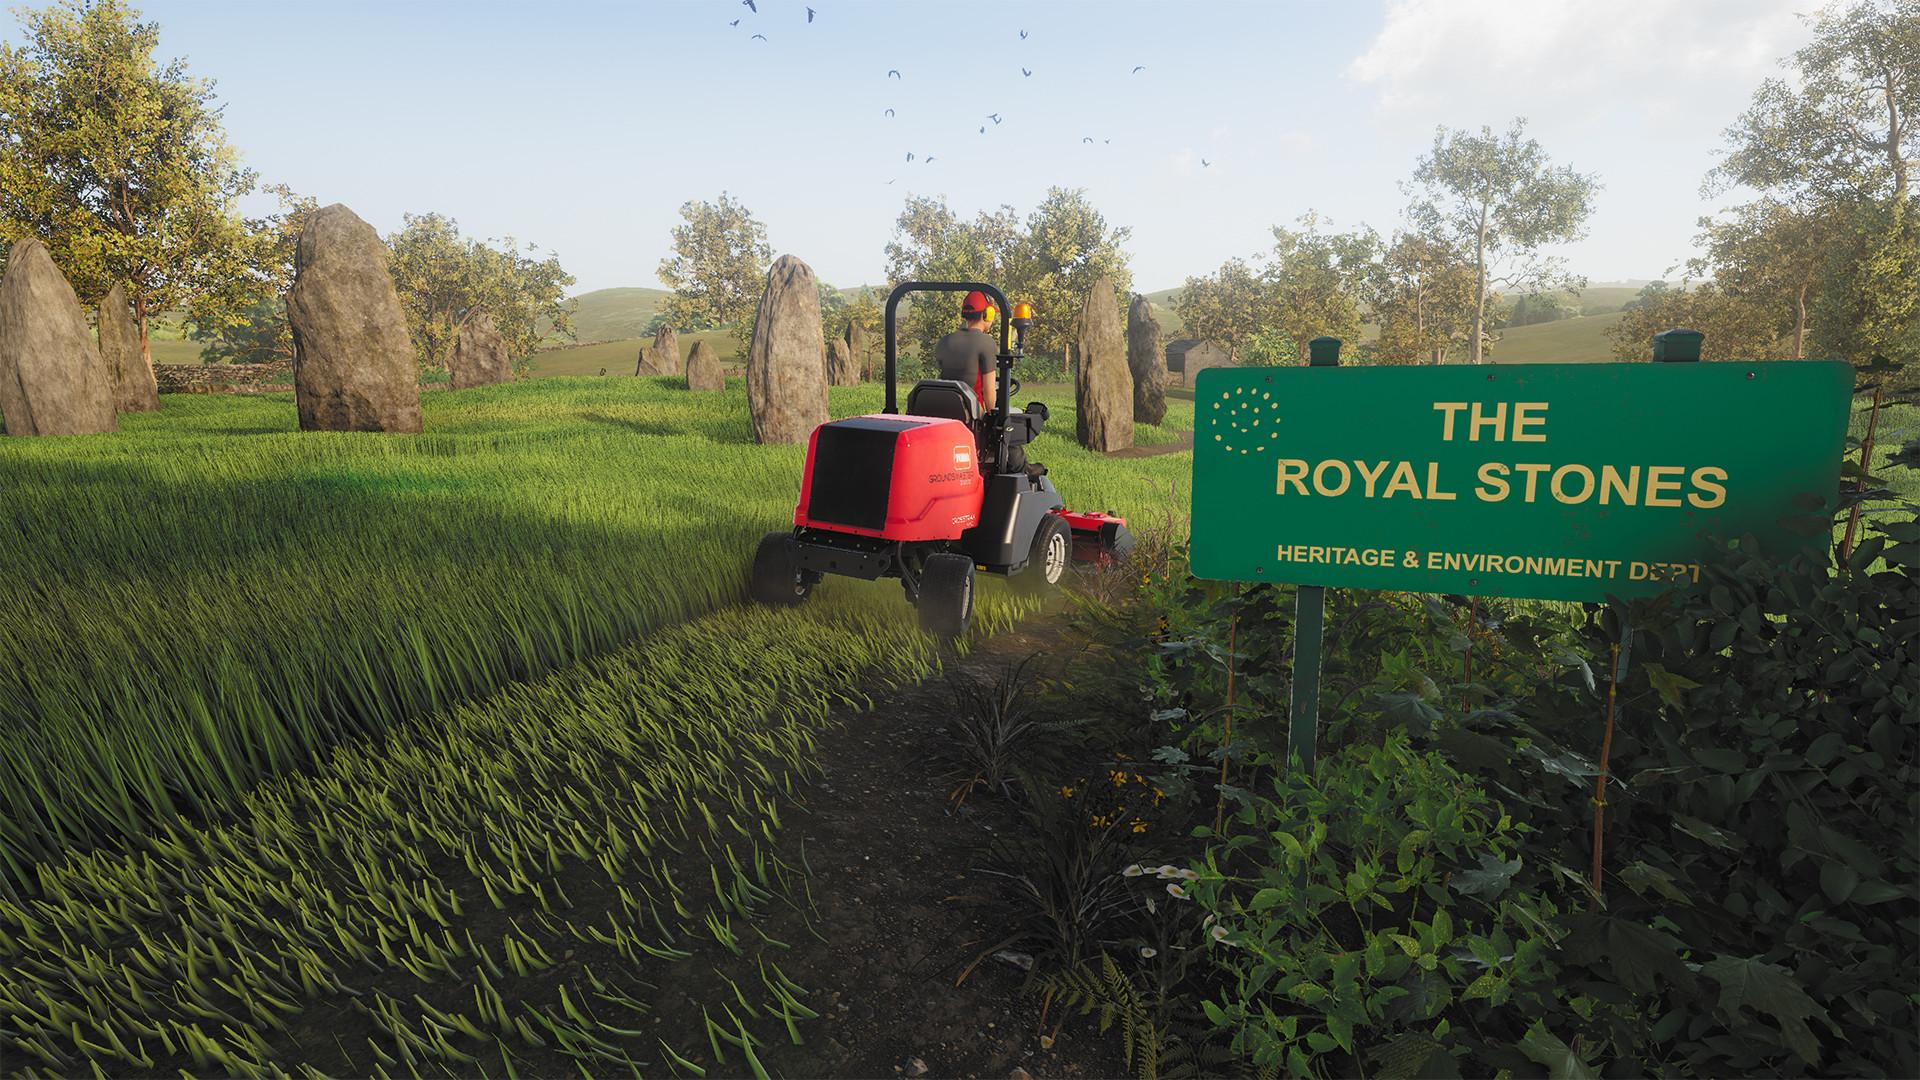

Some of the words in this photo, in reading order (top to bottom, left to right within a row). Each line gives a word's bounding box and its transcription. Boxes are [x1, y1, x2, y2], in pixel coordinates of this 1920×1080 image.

[1433, 402, 1549, 442] THE
[1276, 458, 1457, 501] ROYAL
[1474, 462, 1728, 510] STONES
[1277, 544, 1395, 567] HERITAGE
[1402, 550, 1419, 569] &
[1427, 551, 1622, 579] ENVIRONMENT
